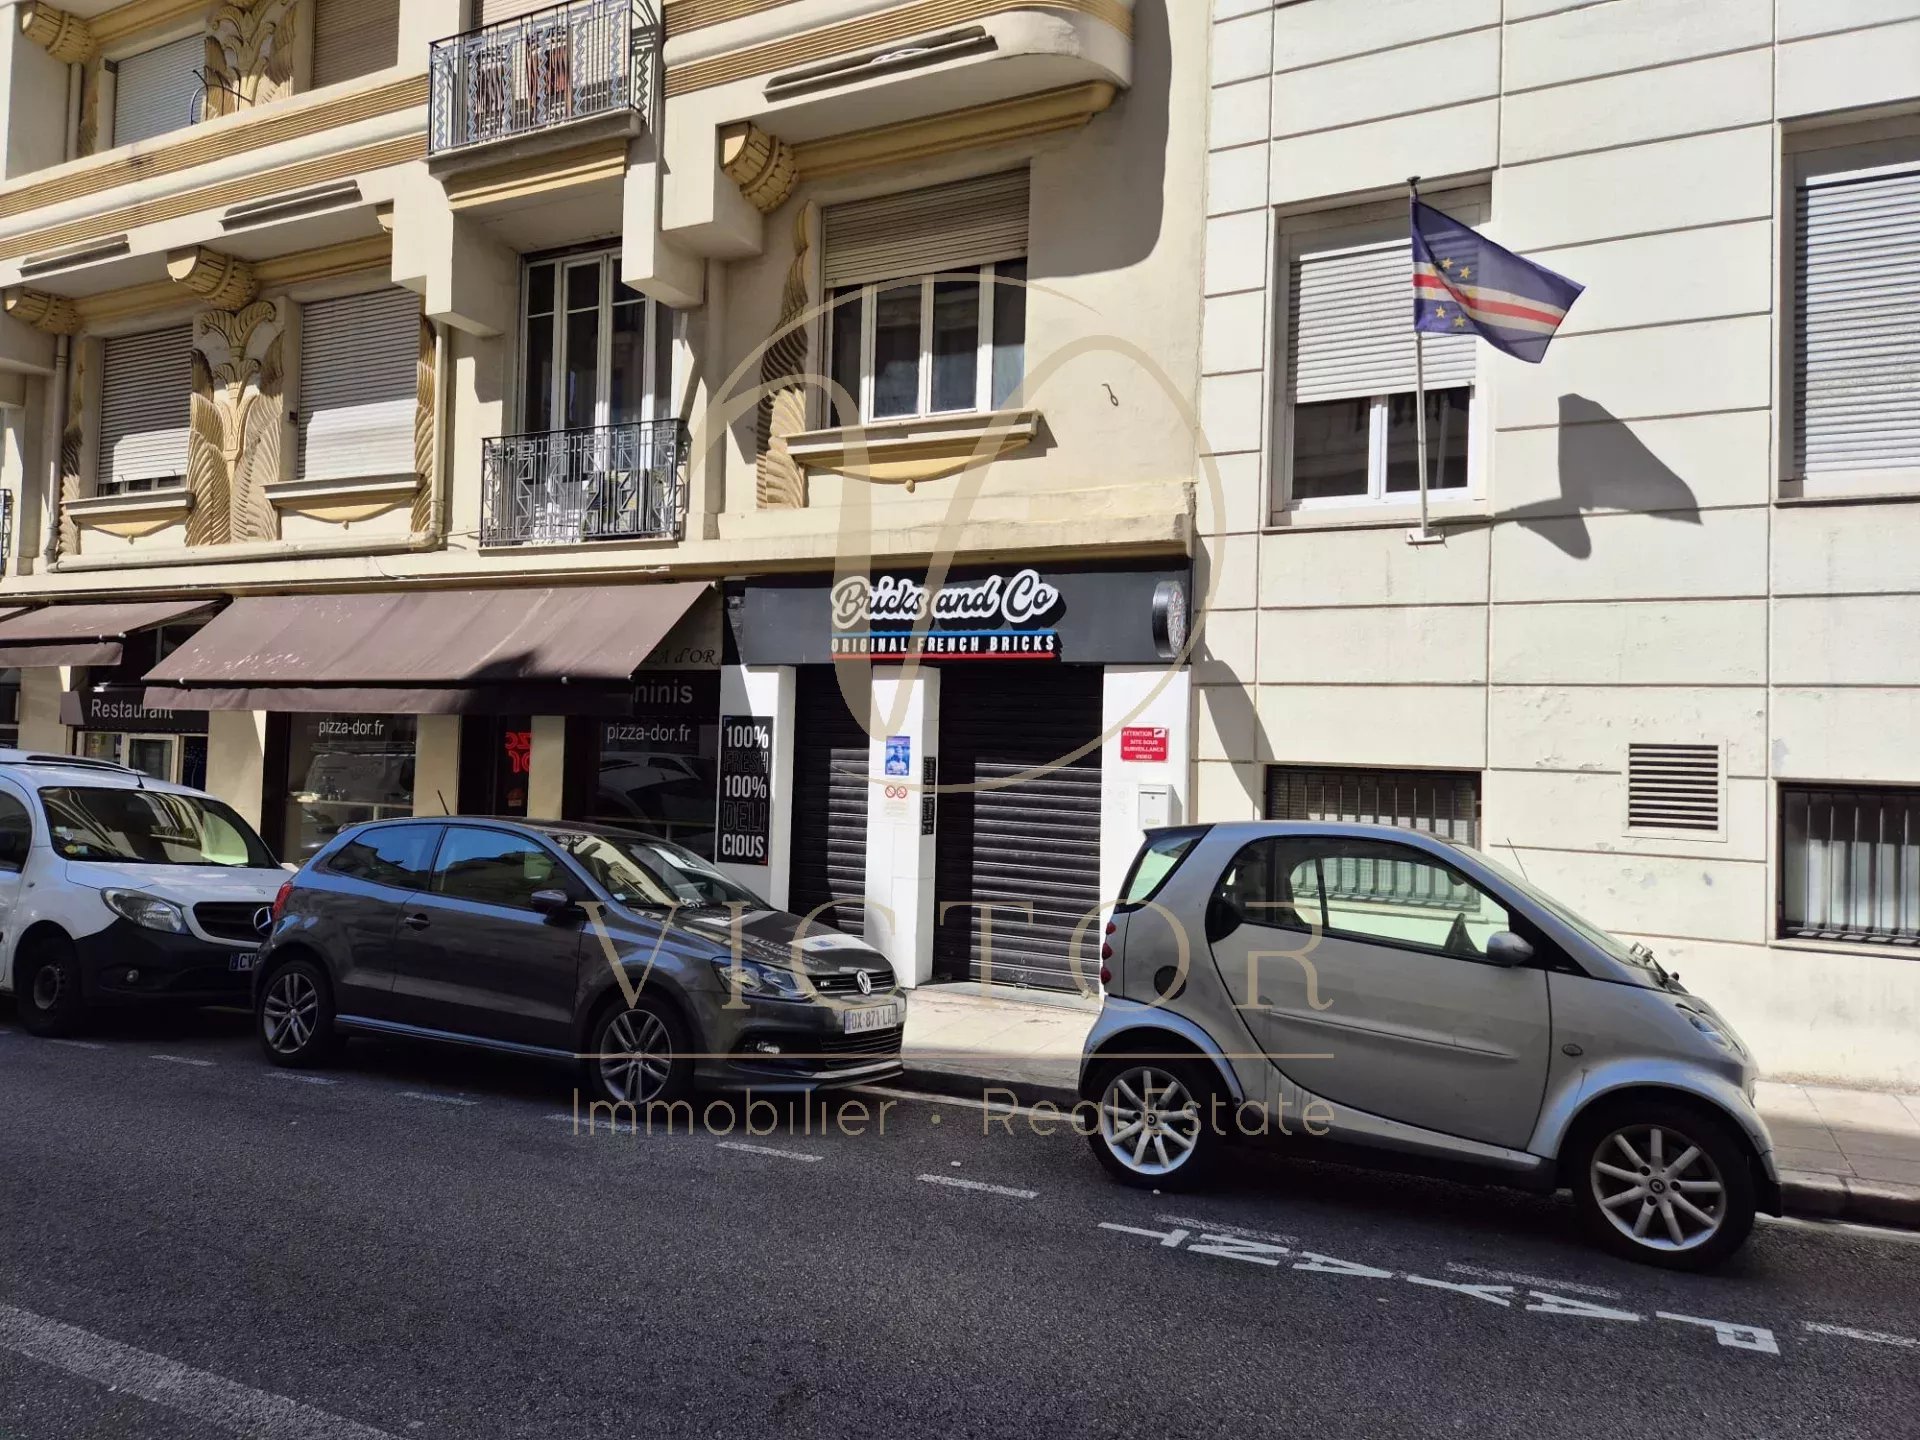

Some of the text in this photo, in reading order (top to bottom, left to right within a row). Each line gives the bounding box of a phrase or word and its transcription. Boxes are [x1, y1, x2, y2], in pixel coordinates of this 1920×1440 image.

[830, 569, 1059, 629] Bricks and Co
[831, 635, 1054, 653] ORIGINAL FRENCH BRICKS
[91, 698, 173, 719] Restaurant
[318, 718, 384, 737] pizza-dor.fr
[606, 722, 692, 744] pizza-dor.fr
[726, 725, 769, 749] 100%
[723, 750, 769, 774] FRESH
[724, 775, 767, 799] 100%
[722, 800, 766, 833] DELI
[722, 833, 765, 857] CIOUS
[1098, 1222, 1781, 1355] PAYANT
